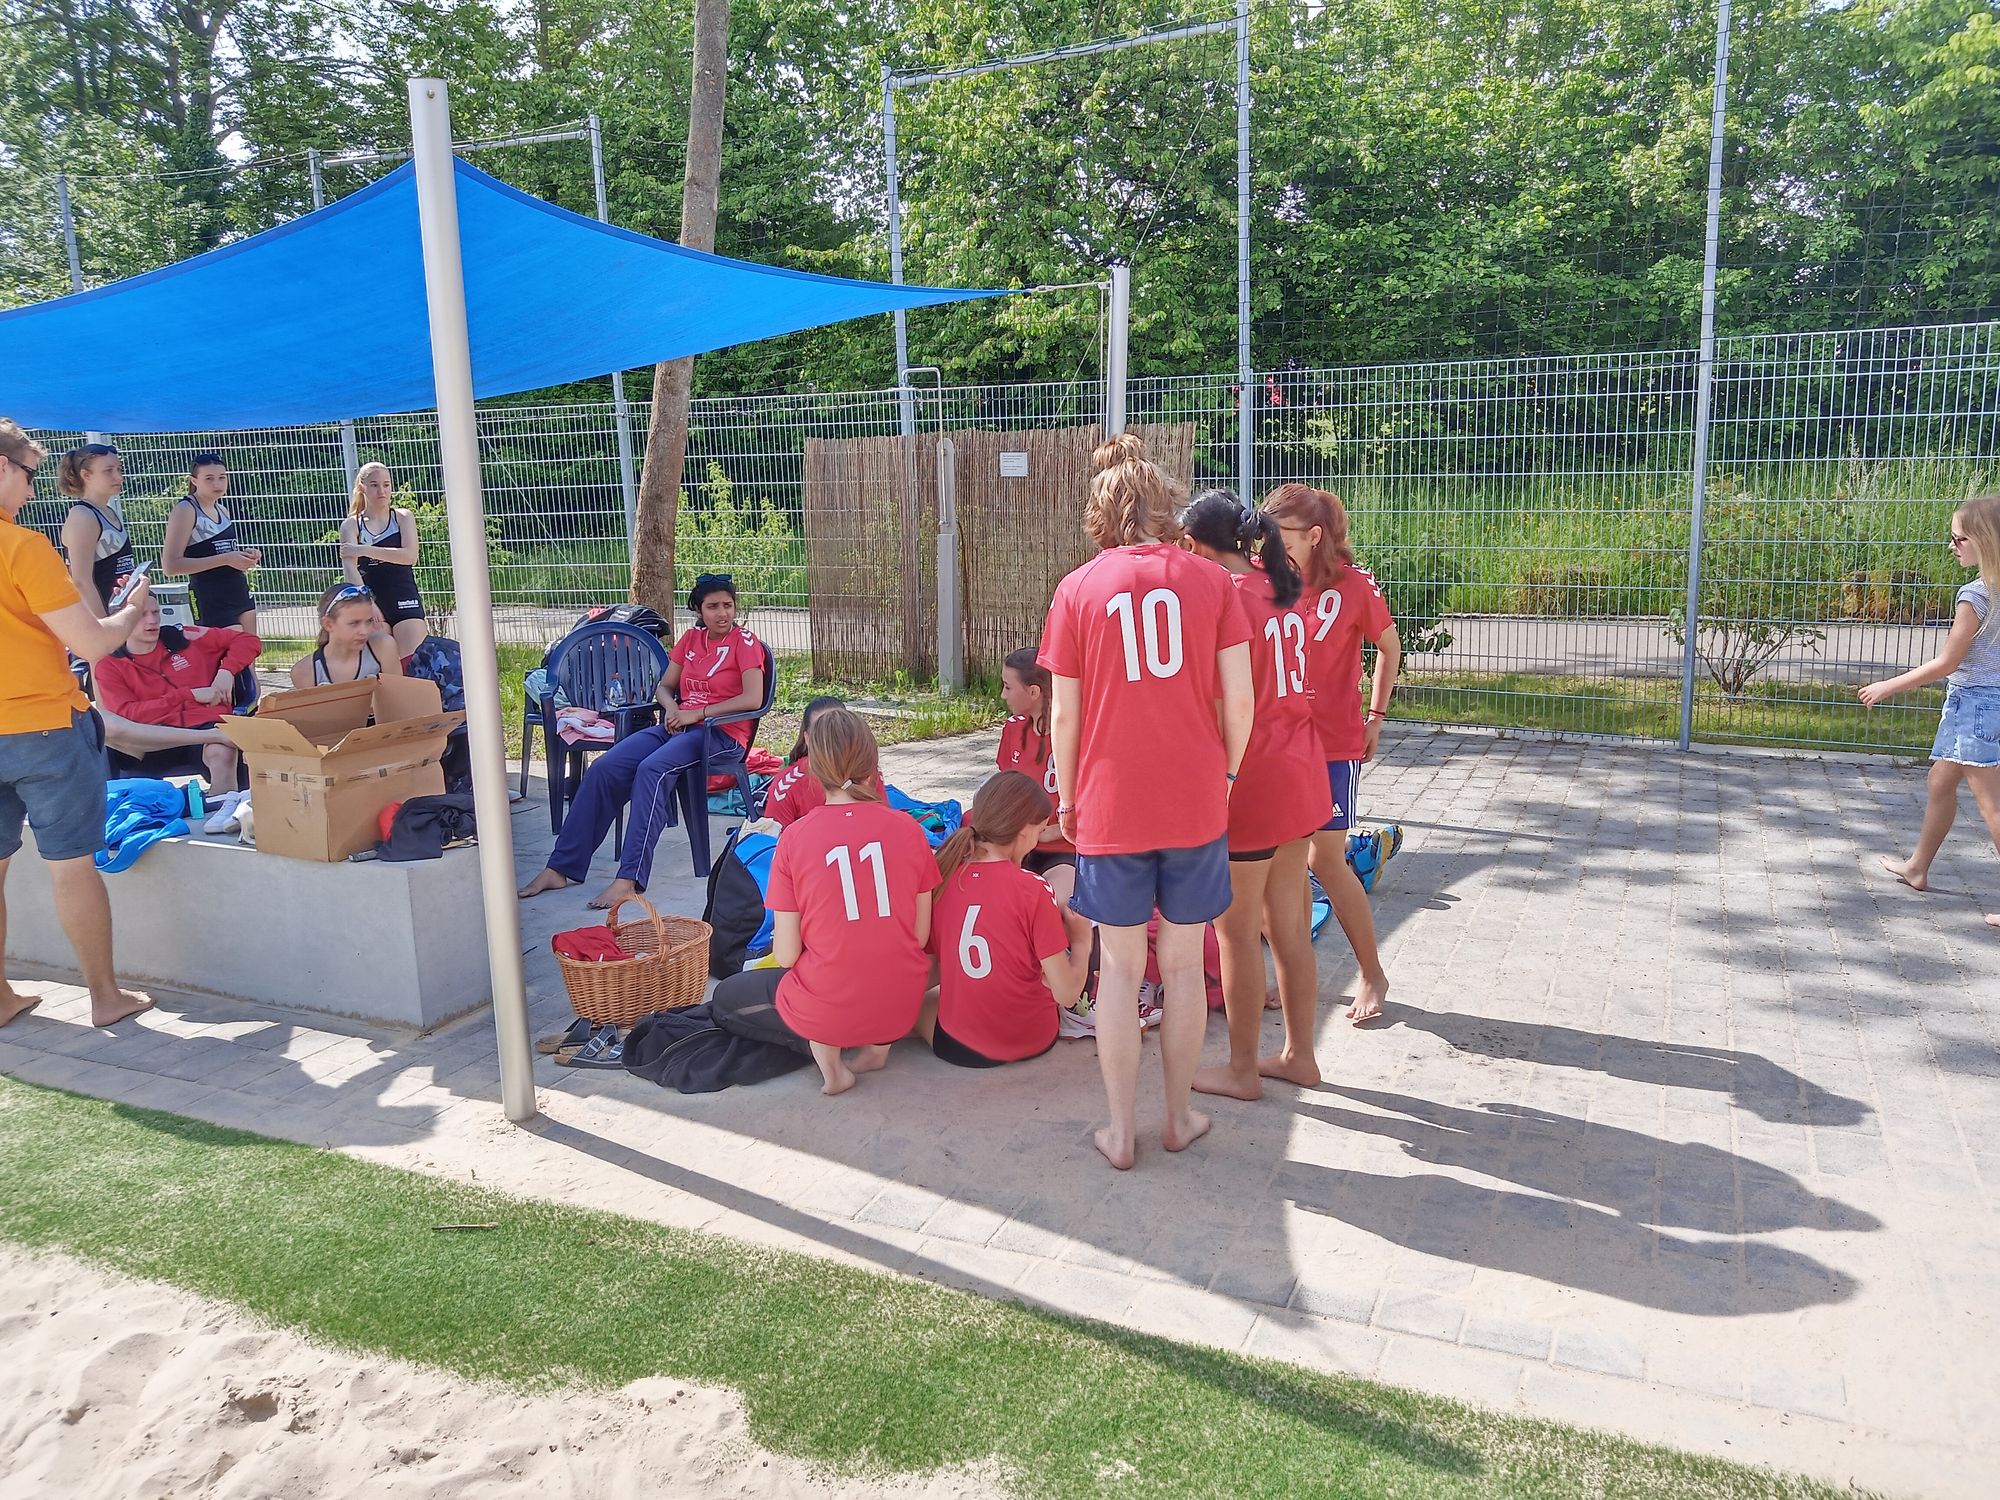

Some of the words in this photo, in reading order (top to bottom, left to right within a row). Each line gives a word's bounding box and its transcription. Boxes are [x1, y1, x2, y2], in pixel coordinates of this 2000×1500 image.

[1106, 588, 1184, 683] 10
[1313, 589, 1342, 642] 9
[706, 645, 730, 678] 7
[1264, 612, 1306, 698] 13
[1043, 752, 1059, 794] 8
[825, 841, 892, 922] 11
[958, 904, 992, 980] 6
